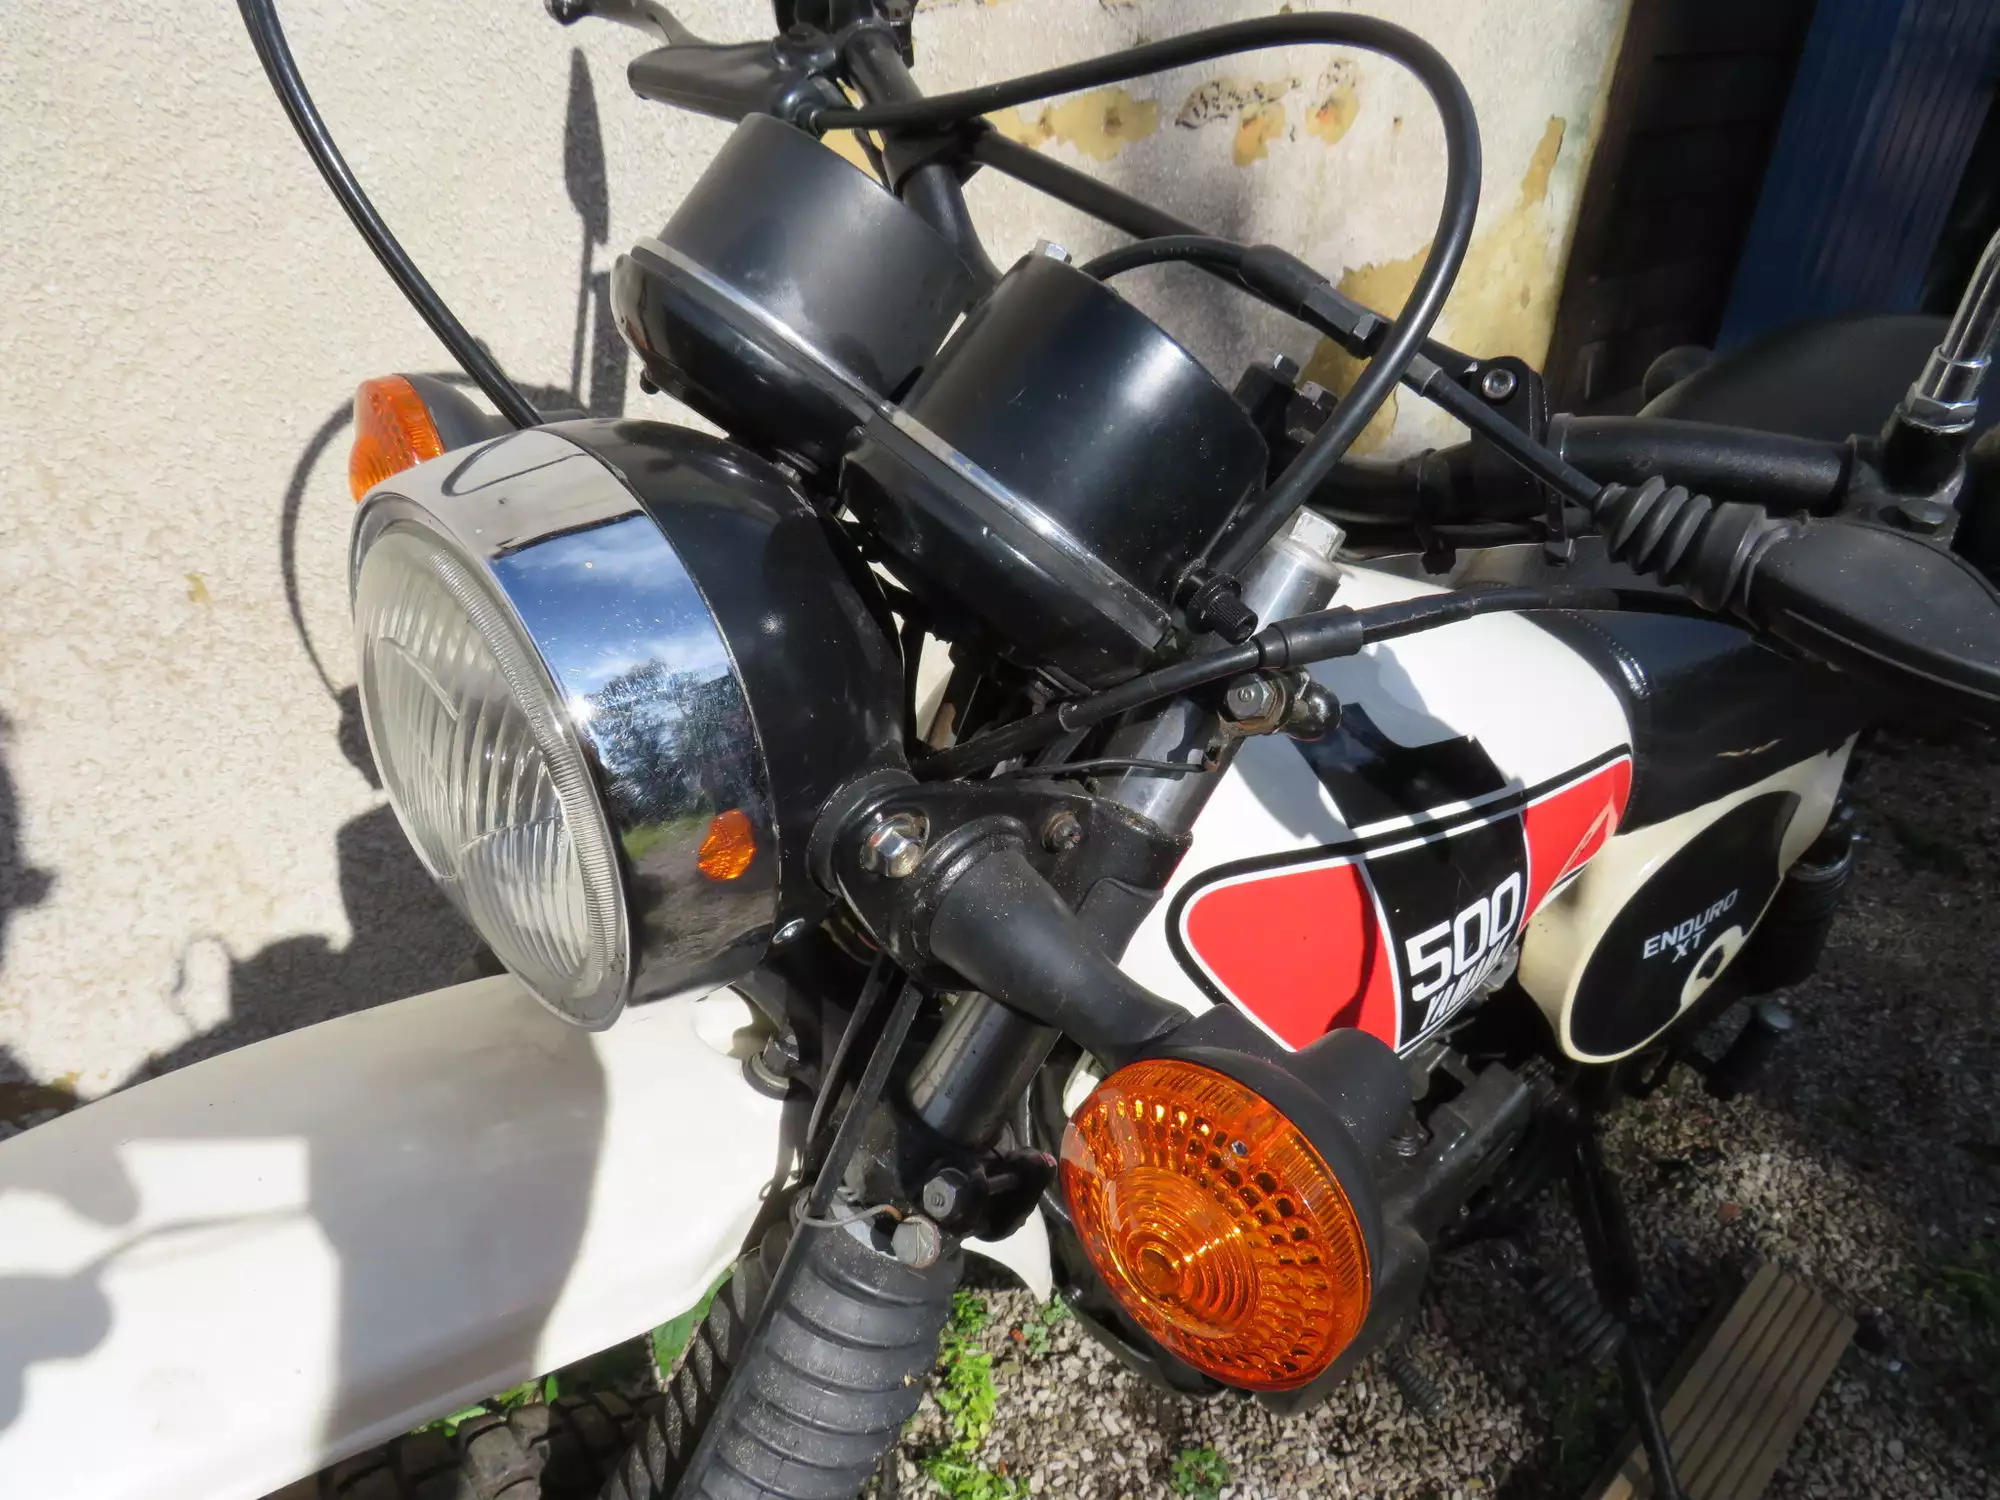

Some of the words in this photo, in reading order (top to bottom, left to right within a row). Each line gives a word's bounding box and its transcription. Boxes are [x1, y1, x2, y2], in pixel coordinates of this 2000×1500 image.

[1405, 871, 1521, 1001] 500
[1643, 888, 1738, 959] ENDURO
[1671, 928, 1706, 963] XT
